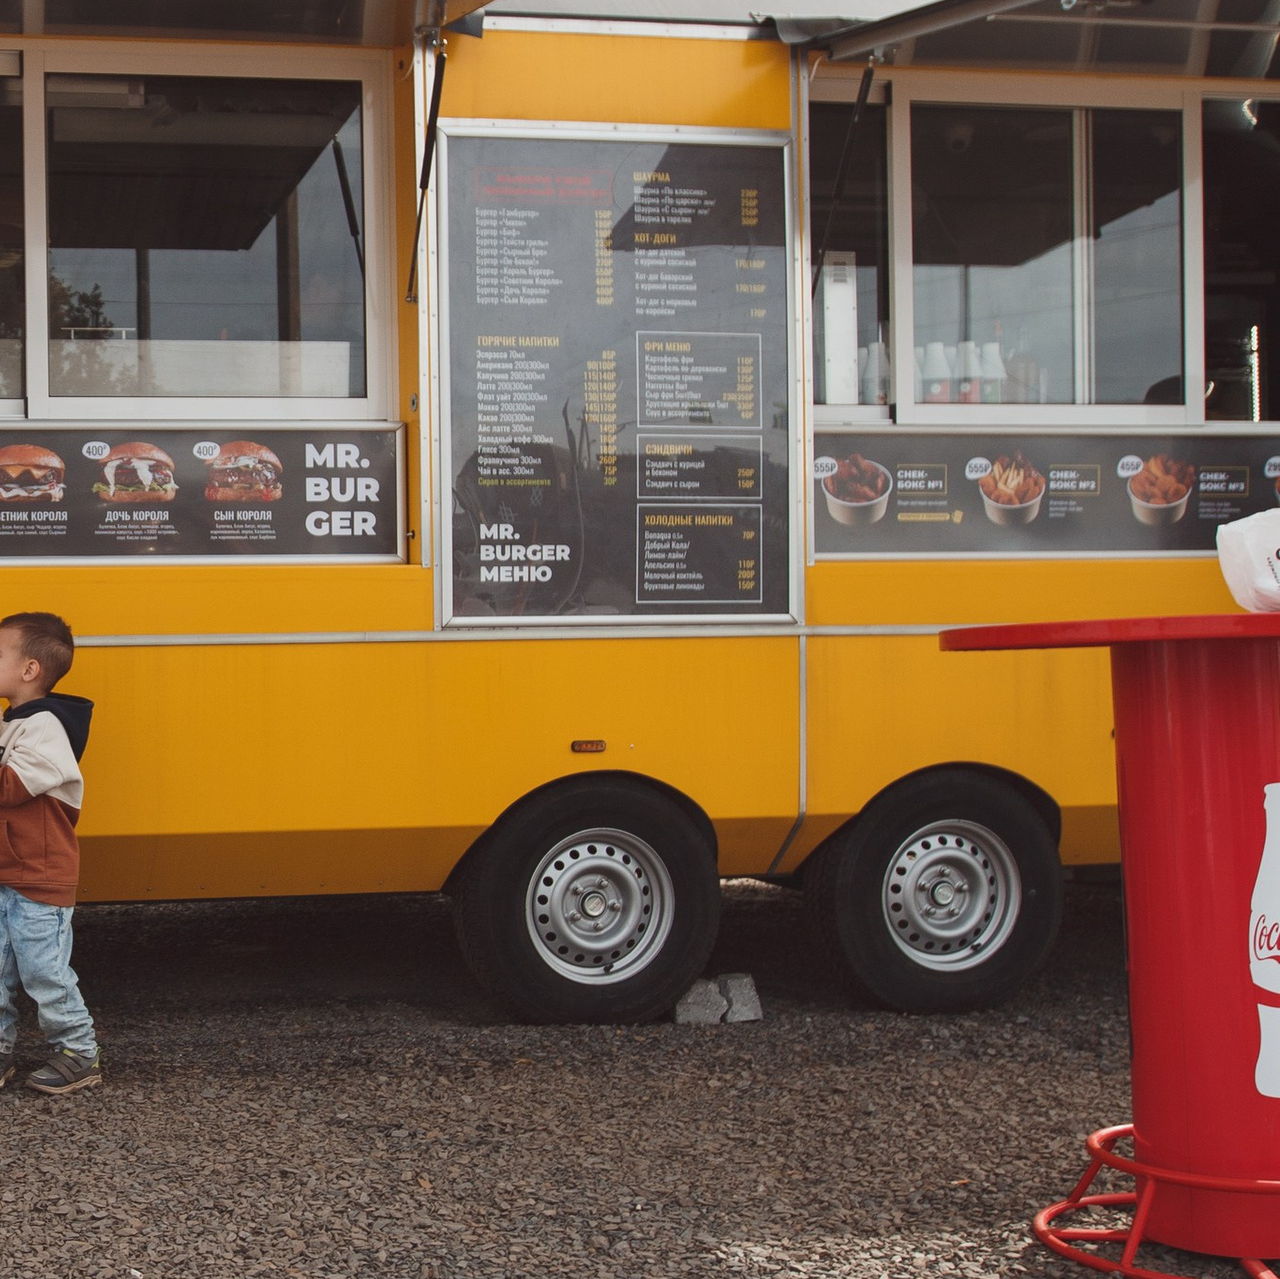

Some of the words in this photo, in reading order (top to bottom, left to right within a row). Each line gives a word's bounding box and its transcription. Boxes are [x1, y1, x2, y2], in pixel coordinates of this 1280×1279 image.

[634, 171, 670, 182] ШАУРМА
[634, 233, 676, 244] ХОТ-ДОГИ
[478, 336, 516, 346] ГОРЯЧИЕ
[519, 336, 559, 347] НАПИТКИ
[645, 342, 663, 352] ФРИ
[666, 342, 690, 351] МЕНЮ
[646, 444, 693, 455] СЭНДВИЧИ
[305, 444, 370, 468] MR.
[306, 477, 380, 502] BUR
[31, 512, 68, 521] КОРОЛЯ
[105, 511, 130, 522] ДОЧЬ
[133, 511, 169, 520] КОРОЛЯ
[214, 511, 234, 520] СЫН
[237, 511, 272, 520] КОРОЛЯ
[645, 515, 693, 526] ХОЛОДНЫЕ
[695, 515, 733, 526] НАПИТКИ
[305, 510, 376, 536] GER
[480, 524, 520, 539] MR.
[480, 544, 570, 561] BURGER
[481, 566, 552, 582] МЕНЮ
